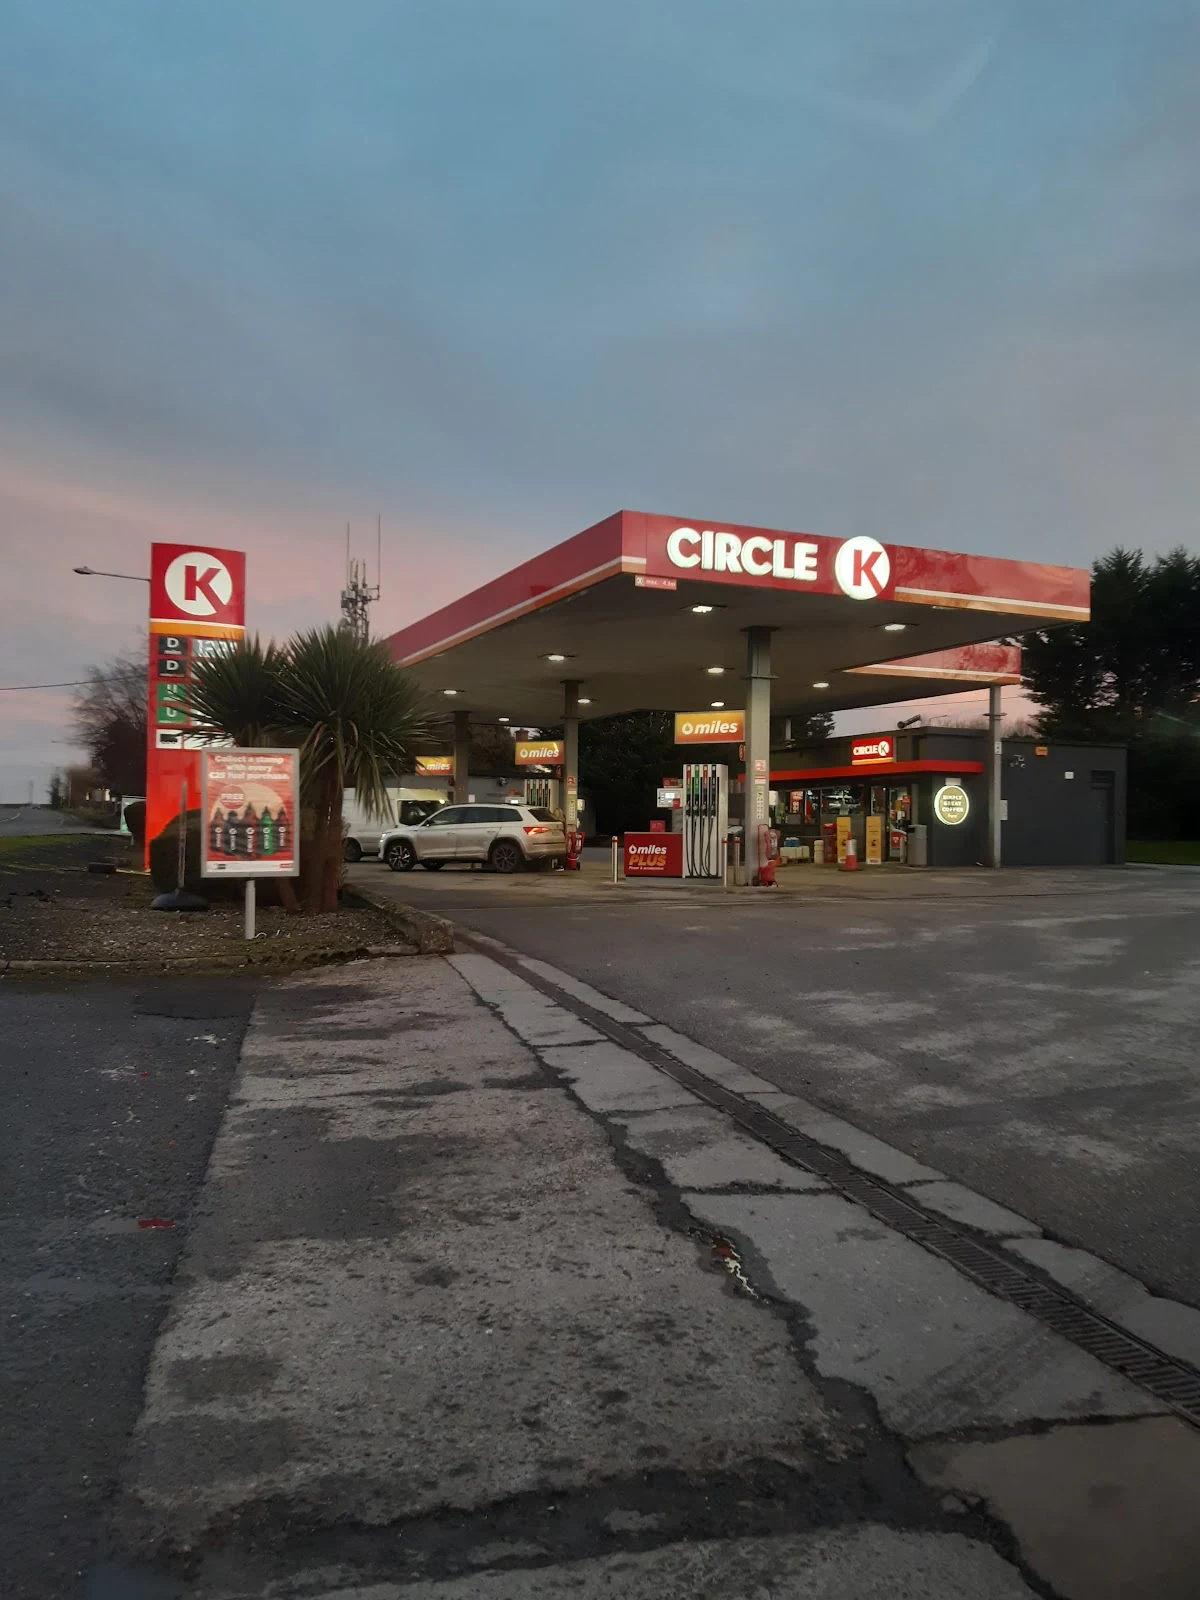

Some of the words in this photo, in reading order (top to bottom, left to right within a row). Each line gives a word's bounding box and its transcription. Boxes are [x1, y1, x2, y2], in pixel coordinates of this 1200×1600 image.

[667, 527, 818, 581] CIRCLE
[167, 637, 179, 648] D
[167, 660, 180, 671] D
[694, 720, 738, 735] miles
[528, 747, 560, 758] miles
[853, 745, 878, 756] CIRCLE
[426, 762, 452, 771] miles
[637, 844, 667, 855] miles
[628, 854, 667, 867] PLUS
